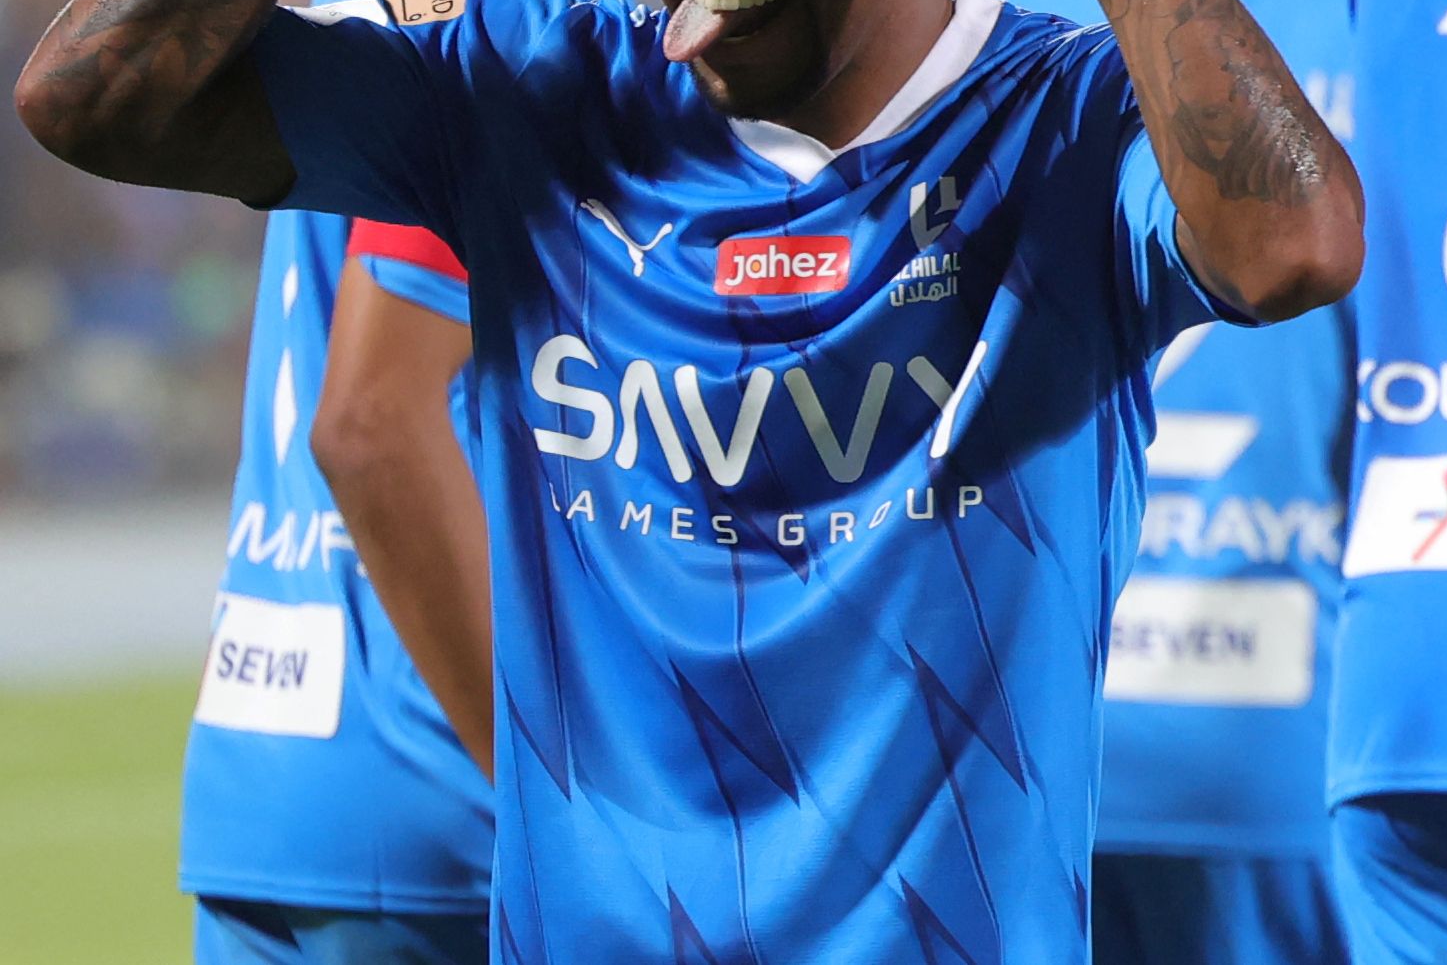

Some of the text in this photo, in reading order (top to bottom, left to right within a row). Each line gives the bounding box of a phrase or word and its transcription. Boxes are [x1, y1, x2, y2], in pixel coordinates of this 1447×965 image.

[724, 244, 839, 287] jahez
[889, 276, 959, 307] الهلال
[531, 334, 988, 487] SAVVY
[548, 482, 739, 545] AMES
